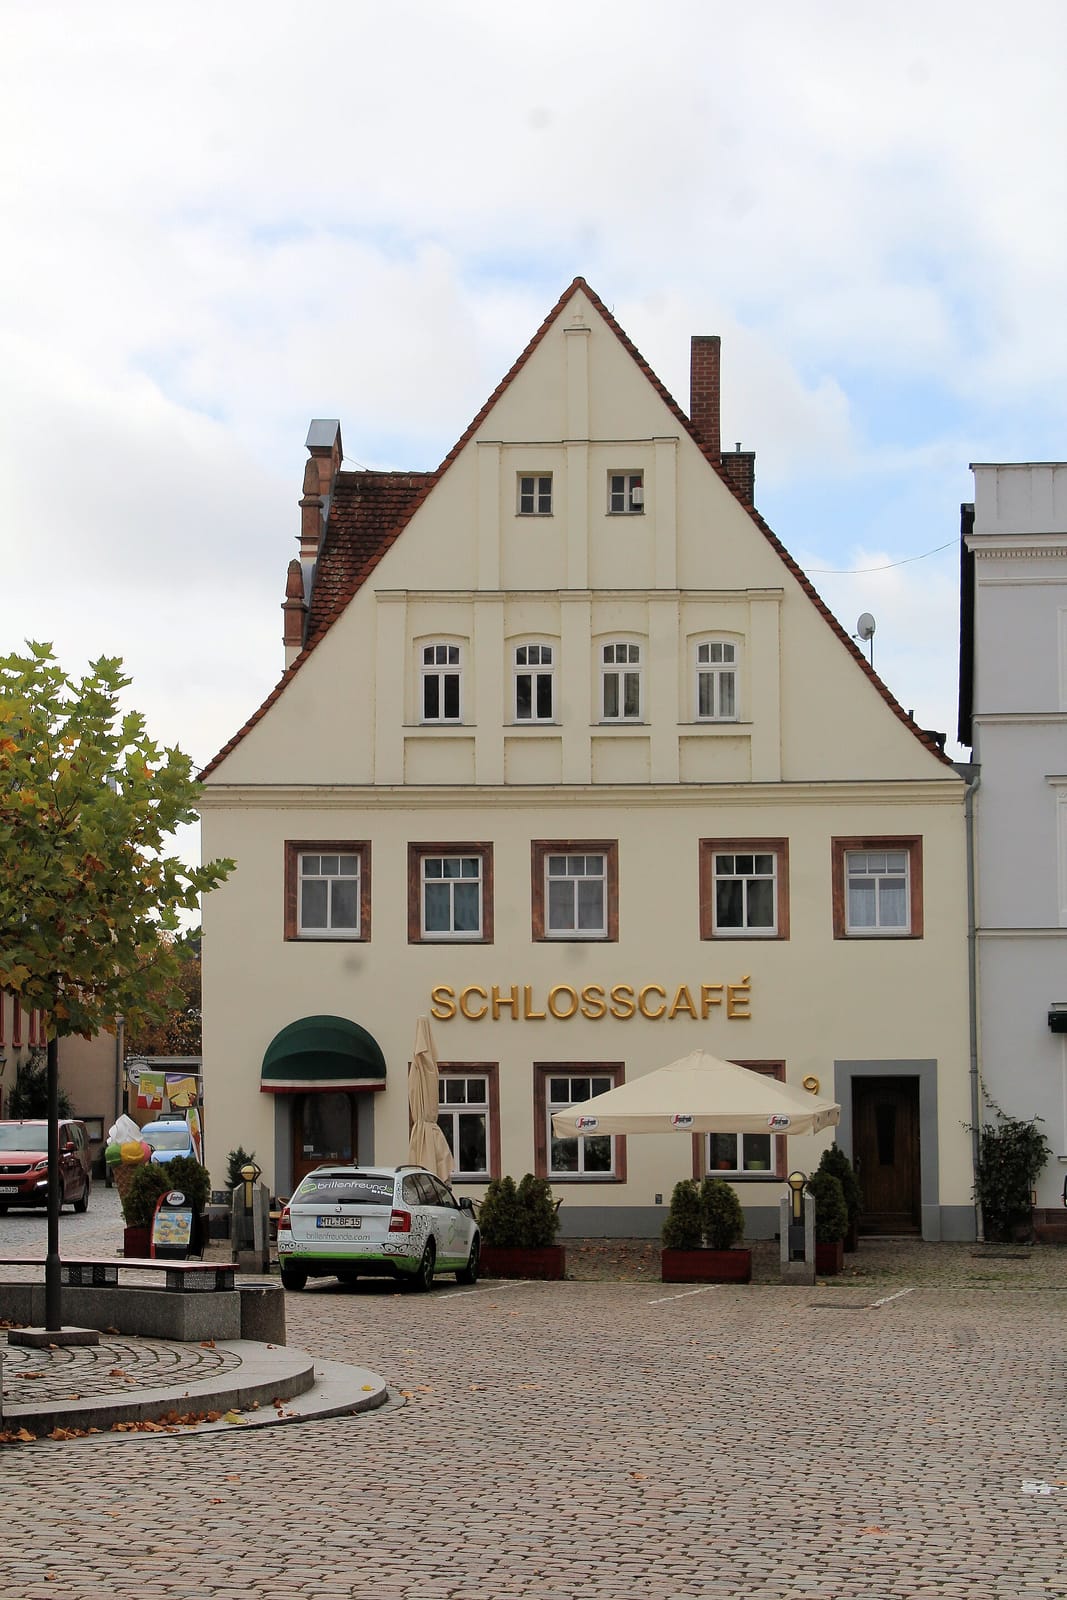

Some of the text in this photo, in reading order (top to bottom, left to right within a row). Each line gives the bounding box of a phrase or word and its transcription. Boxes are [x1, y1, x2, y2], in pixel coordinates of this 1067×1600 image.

[430, 975, 752, 1021] SCHLOSSCAFÉ
[803, 1075, 819, 1095] 9
[321, 1217, 360, 1226] MTL BF 15
